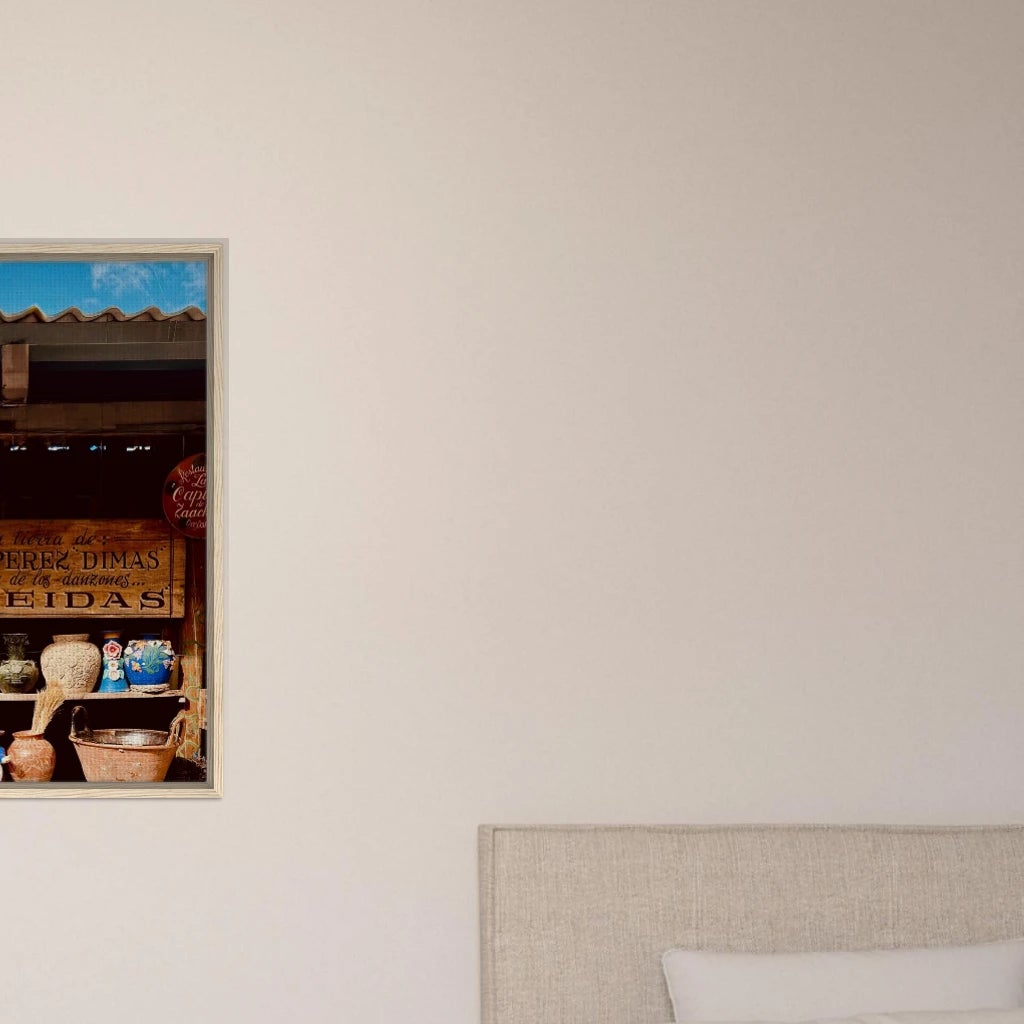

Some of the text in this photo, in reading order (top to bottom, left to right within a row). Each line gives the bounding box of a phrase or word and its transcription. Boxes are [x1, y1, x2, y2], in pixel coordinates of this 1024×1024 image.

[178, 463, 207, 483] Restau
[12, 529, 64, 546] tierra
[10, 568, 26, 586] de
